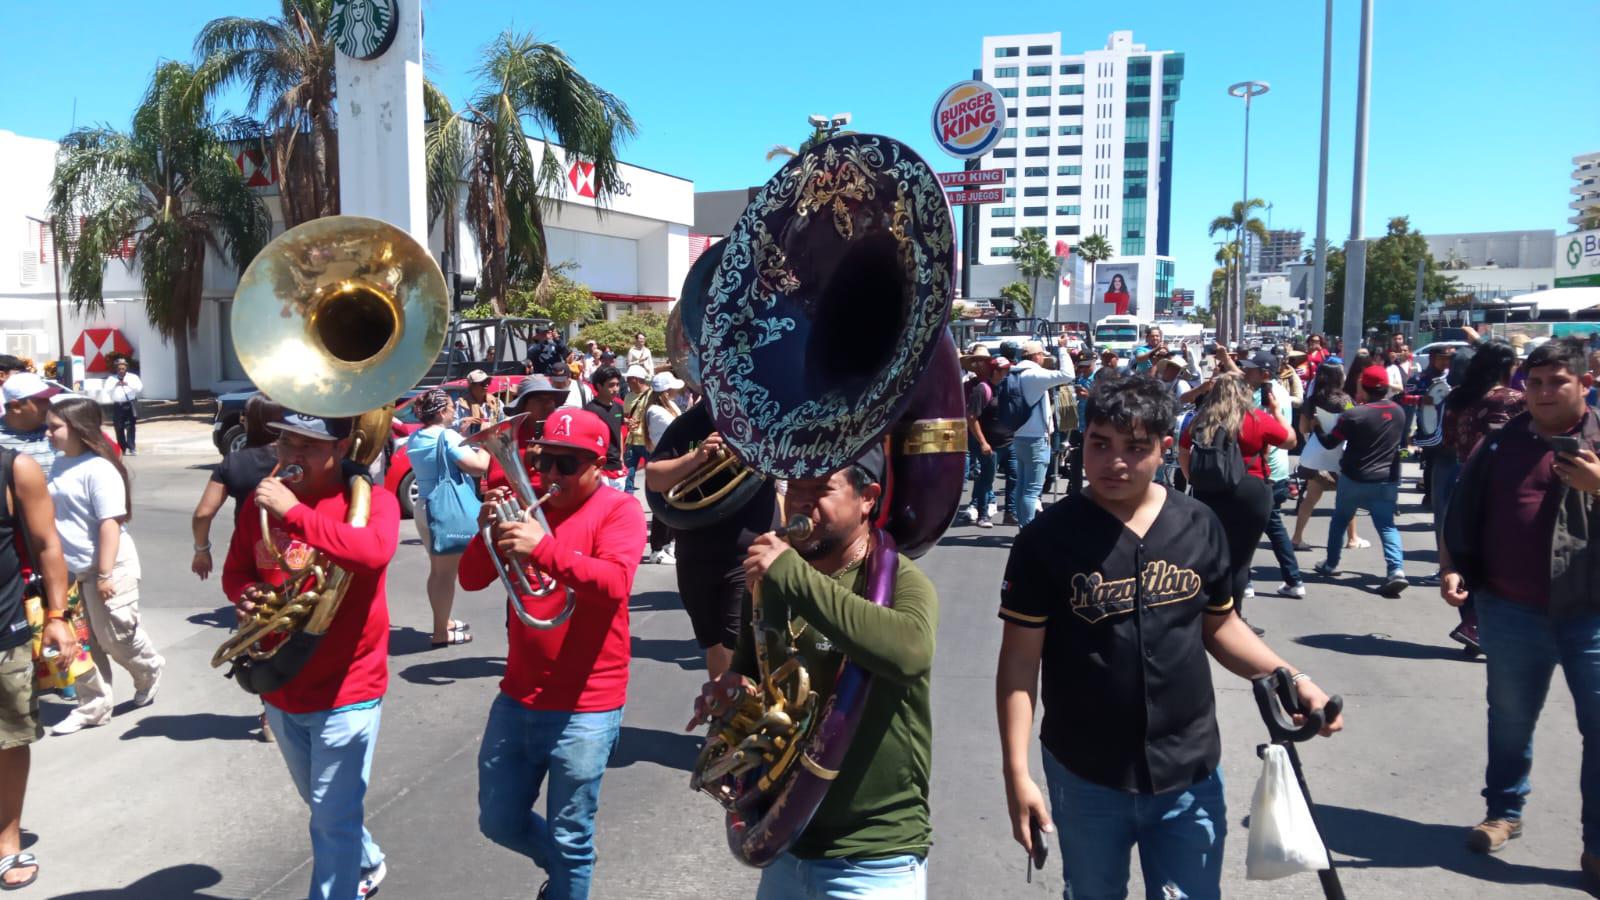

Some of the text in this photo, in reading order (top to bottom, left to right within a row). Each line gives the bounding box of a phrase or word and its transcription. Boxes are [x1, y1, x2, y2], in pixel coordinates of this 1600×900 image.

[940, 92, 993, 125] BURGER
[942, 104, 996, 144] KING
[942, 171, 1000, 183] UTO KING
[612, 178, 632, 197] SBC
[956, 193, 967, 201] DE
[968, 191, 1000, 201] JUEGOS
